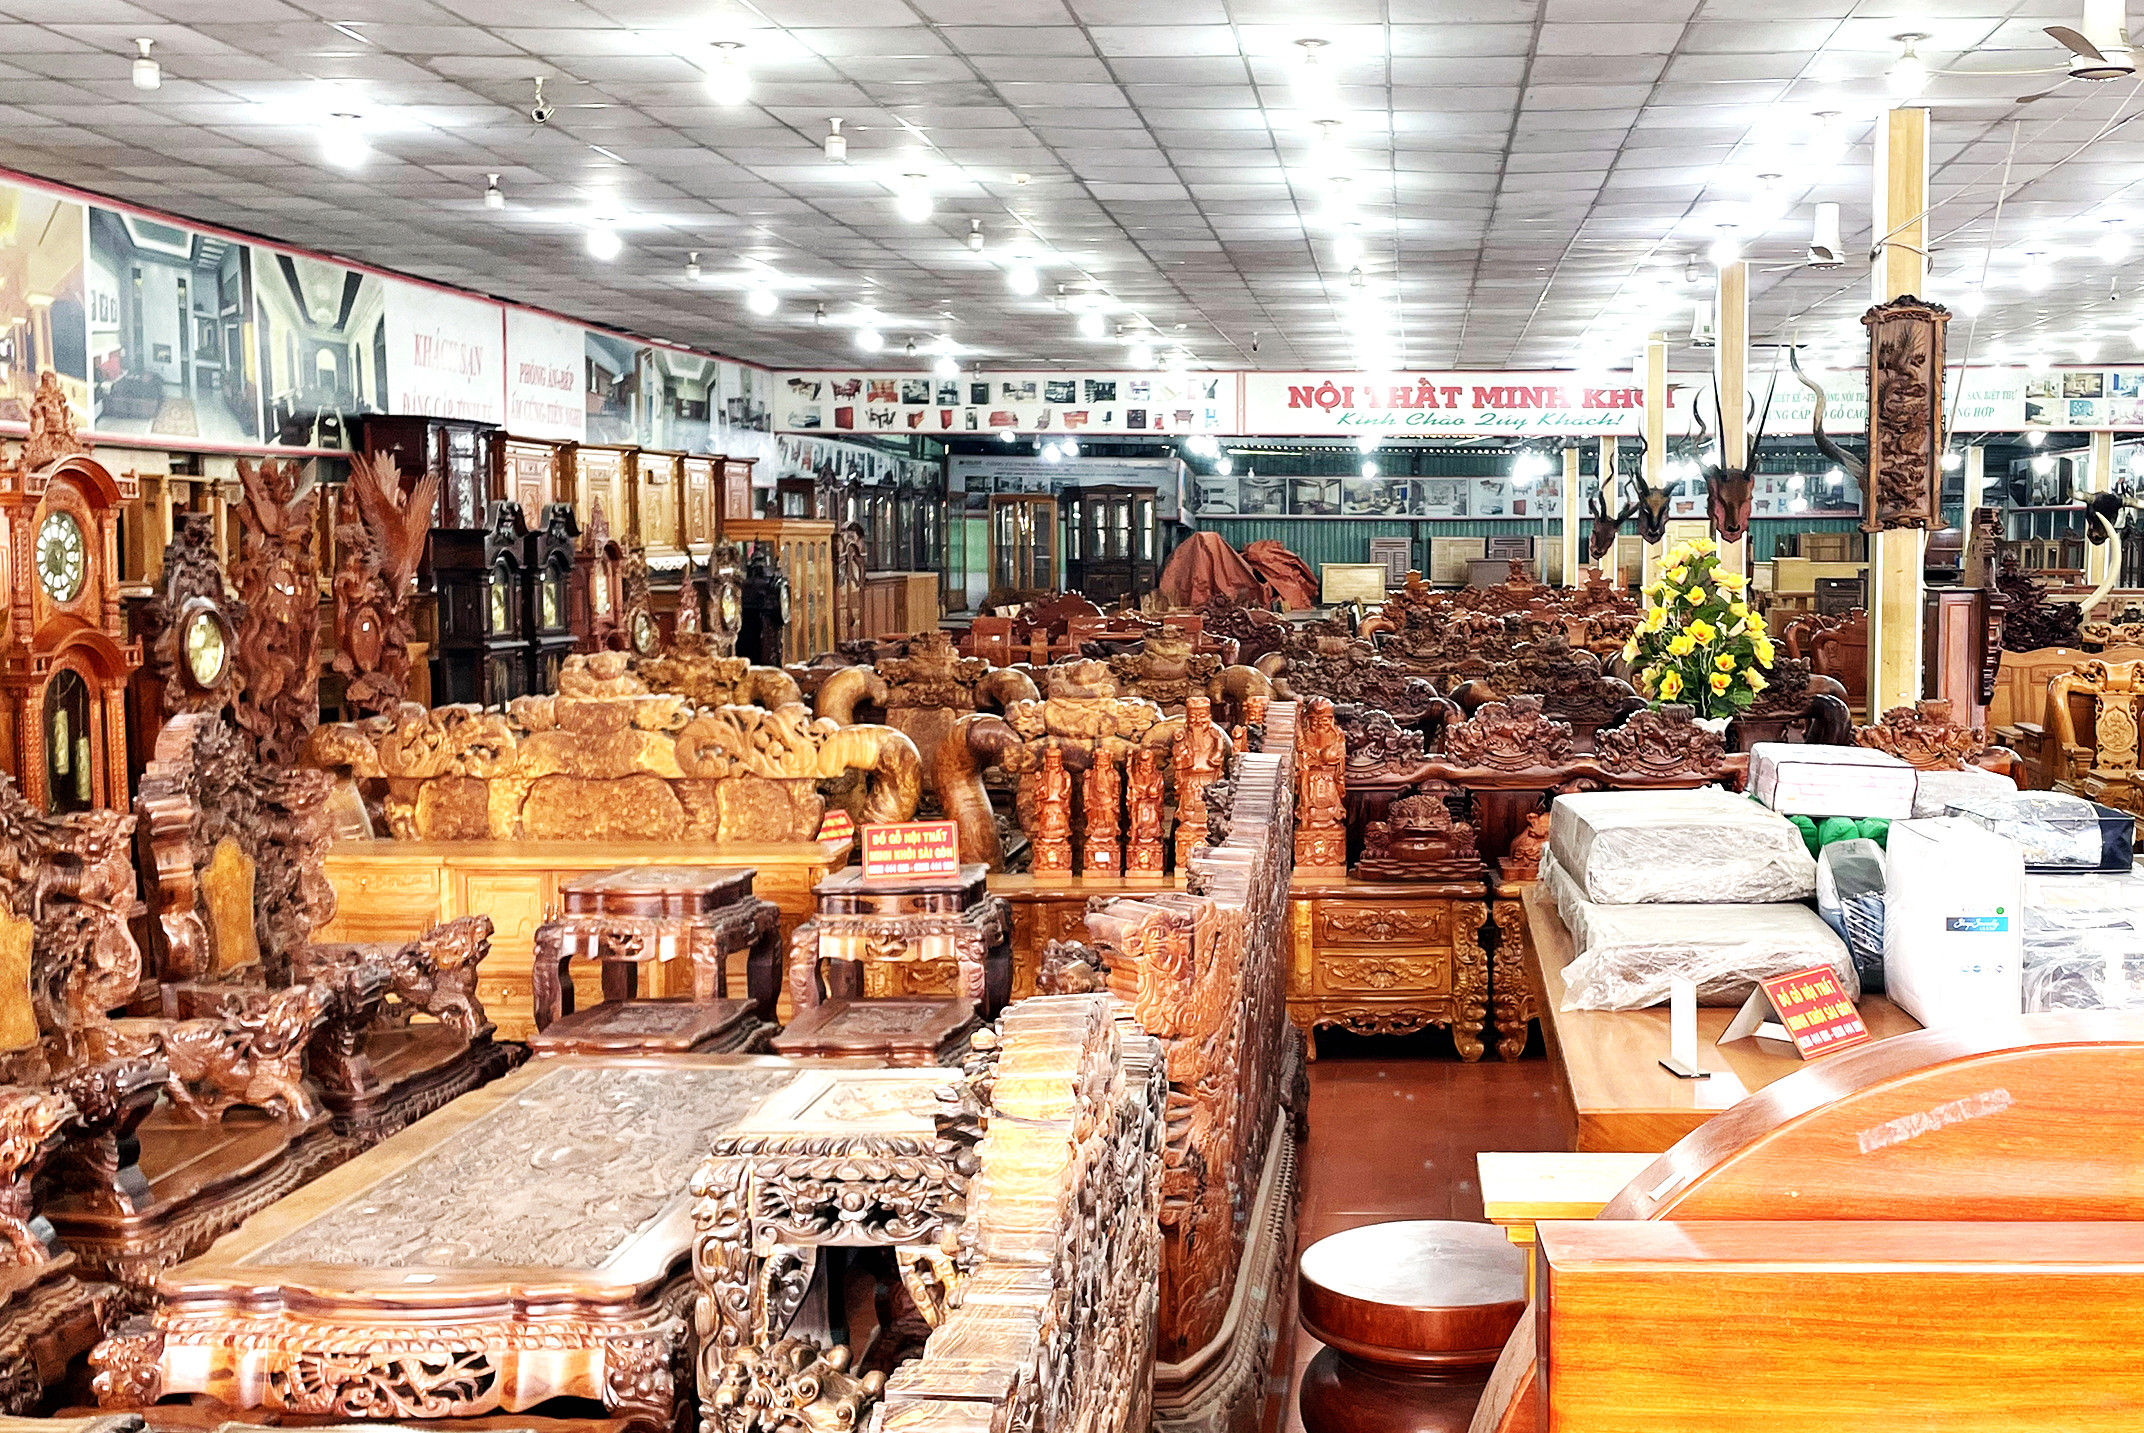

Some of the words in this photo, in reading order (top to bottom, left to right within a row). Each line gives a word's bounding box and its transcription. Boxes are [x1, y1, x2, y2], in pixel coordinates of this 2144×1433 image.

[1288, 380, 1354, 413] NỘI
[1472, 386, 1572, 409] MINH
[1582, 386, 1675, 409] KHI
[1768, 409, 1789, 420] UNG
